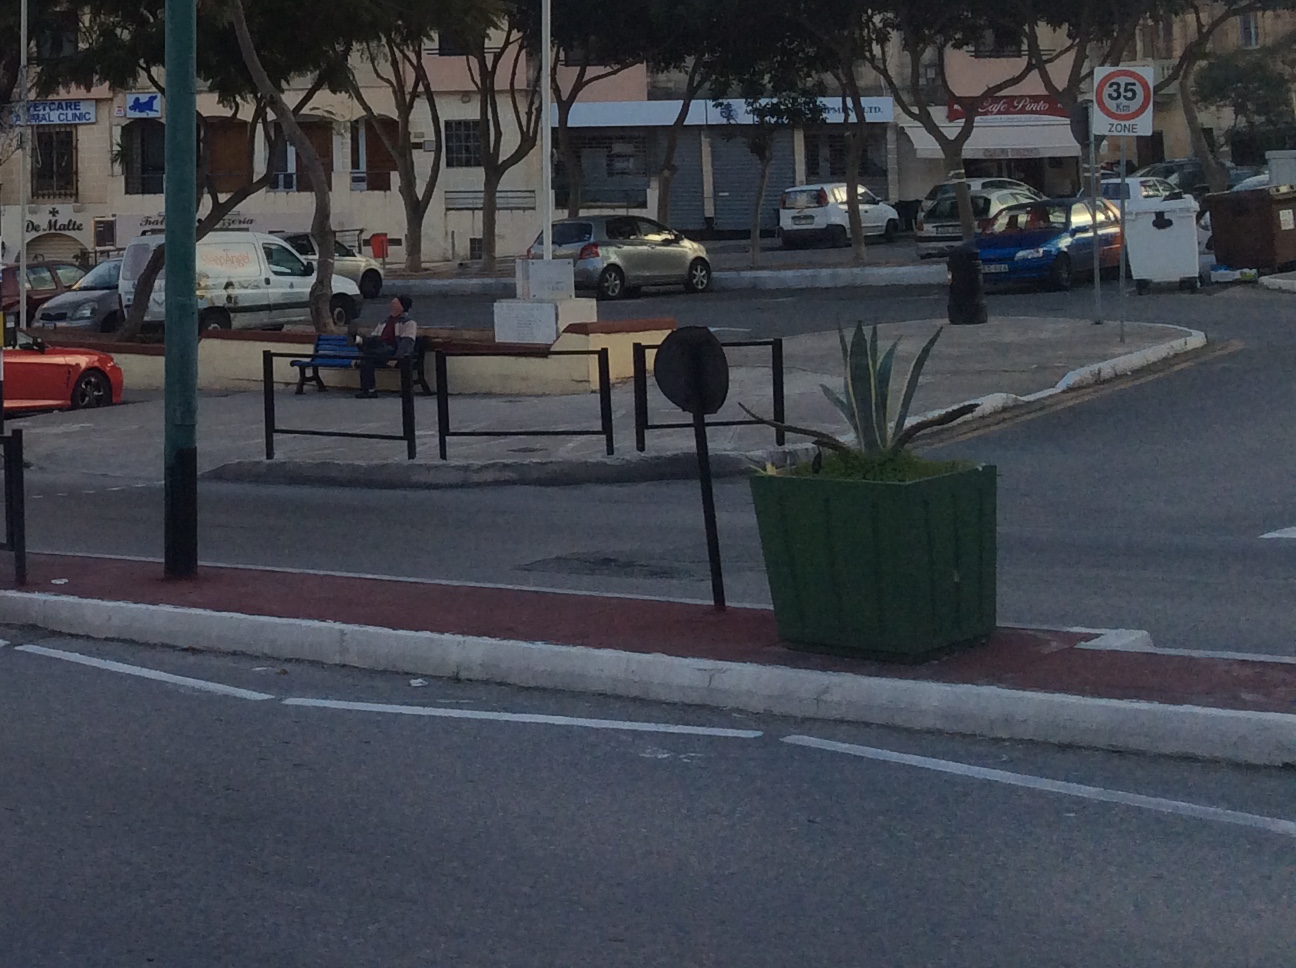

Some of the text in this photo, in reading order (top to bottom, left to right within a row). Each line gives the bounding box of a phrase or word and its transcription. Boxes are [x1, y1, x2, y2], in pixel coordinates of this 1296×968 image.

[1107, 81, 1137, 101] 35
[1010, 97, 1049, 112] Pinto
[1115, 102, 1131, 113] Km
[58, 112, 91, 122] CLINIC
[1108, 123, 1138, 133] ZONE
[26, 220, 41, 232] De
[43, 219, 84, 232] Malte
